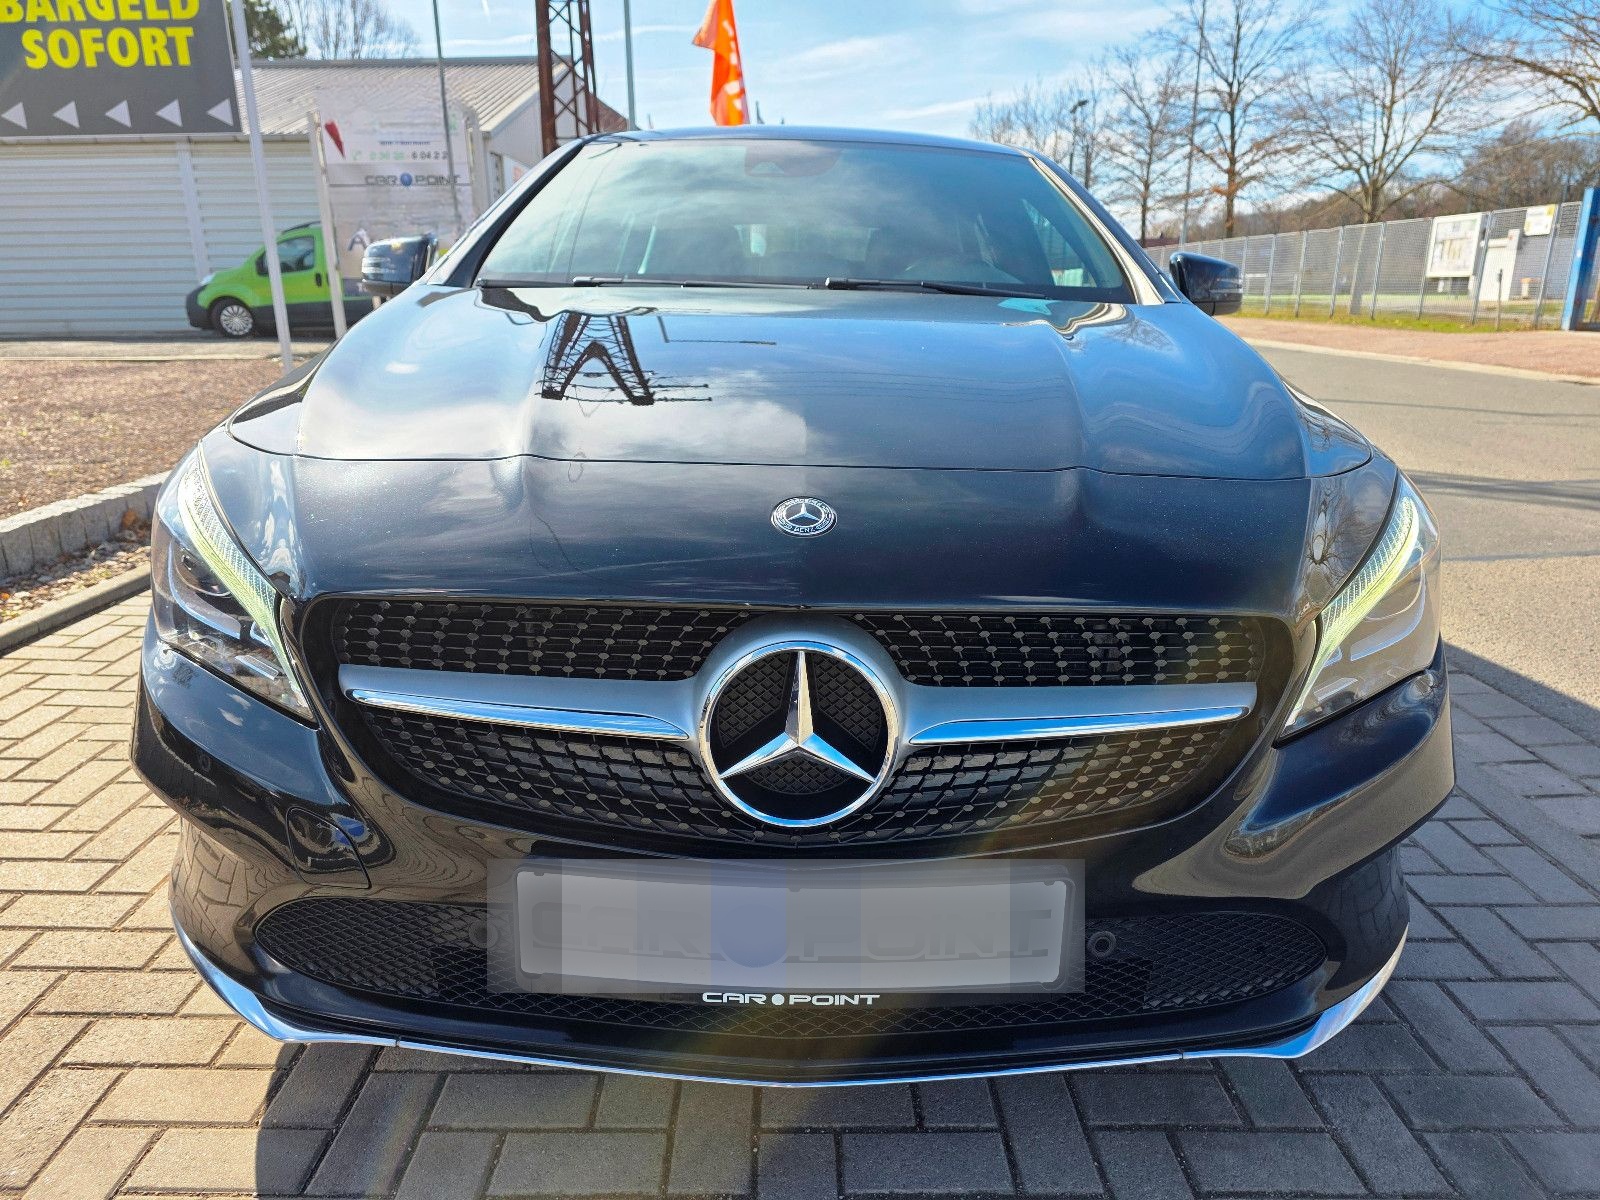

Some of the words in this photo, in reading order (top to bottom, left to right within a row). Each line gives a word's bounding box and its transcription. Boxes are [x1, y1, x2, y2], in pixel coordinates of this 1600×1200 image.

[21, 26, 194, 69] SOFORT
[702, 992, 767, 1005] CAR
[789, 994, 881, 1006] POINT
